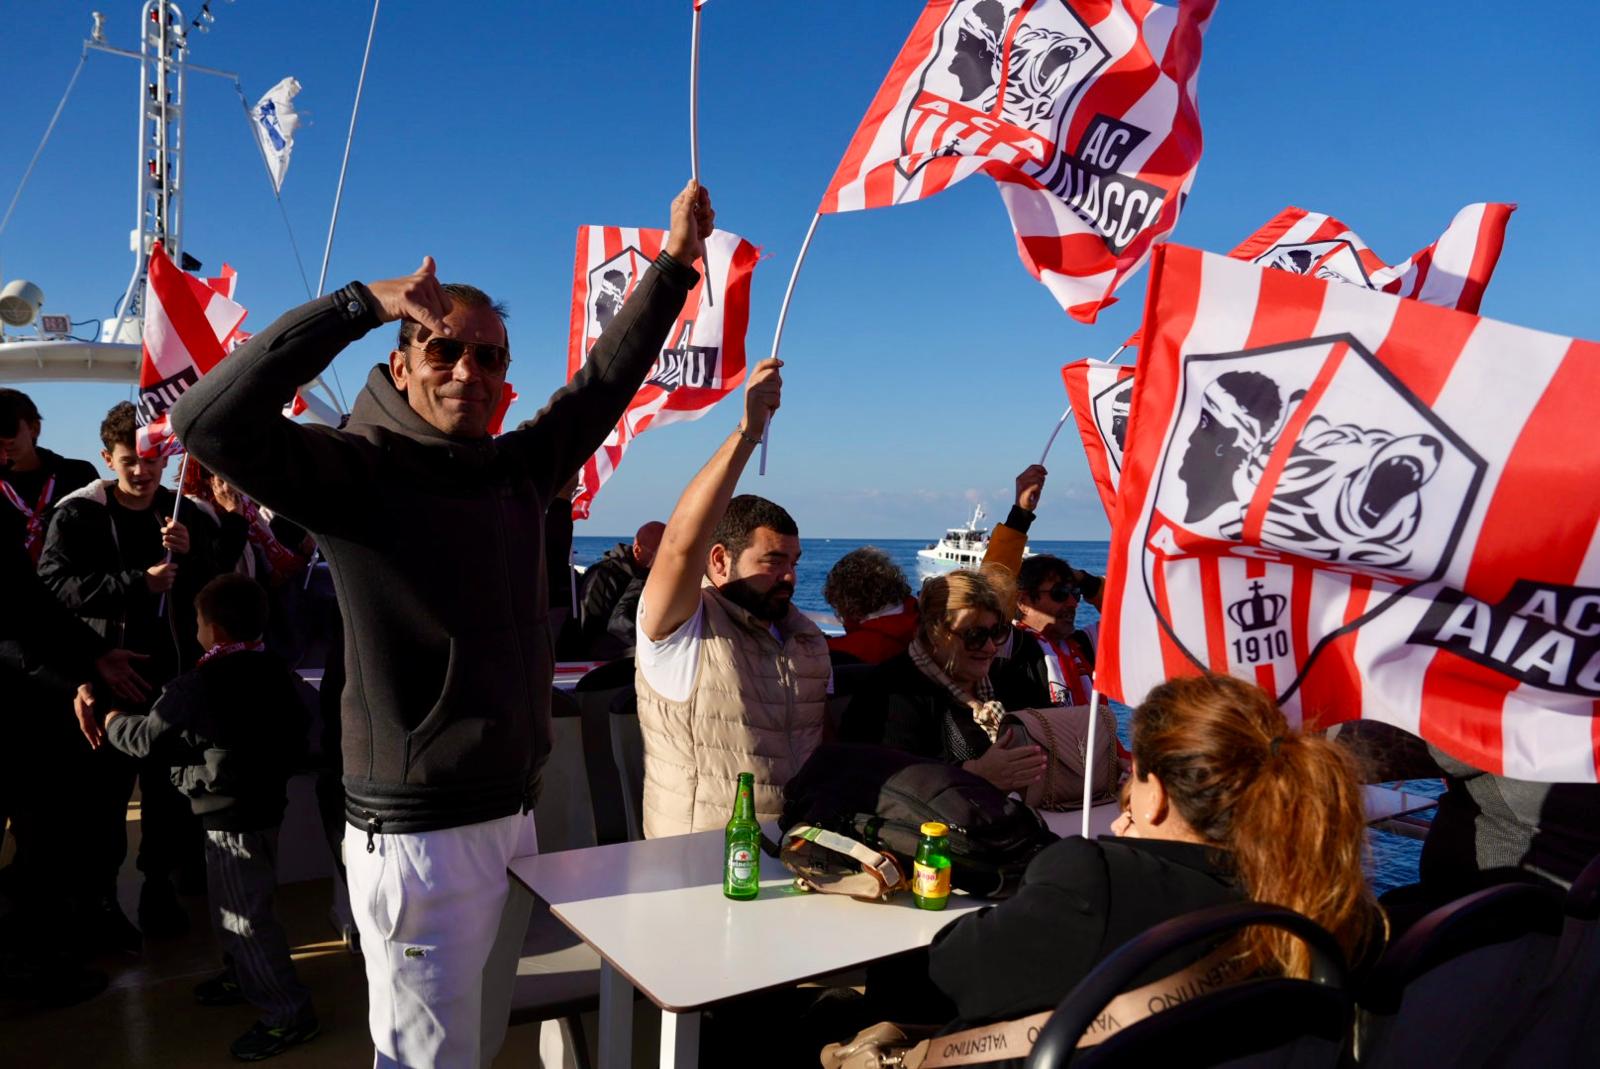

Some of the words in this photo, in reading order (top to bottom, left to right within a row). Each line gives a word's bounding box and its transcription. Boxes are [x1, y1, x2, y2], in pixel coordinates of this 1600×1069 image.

[1080, 122, 1131, 169] AC
[1516, 590, 1600, 637] AC
[1232, 630, 1289, 664] 1910
[943, 1033, 1008, 1058] VALENTINO
